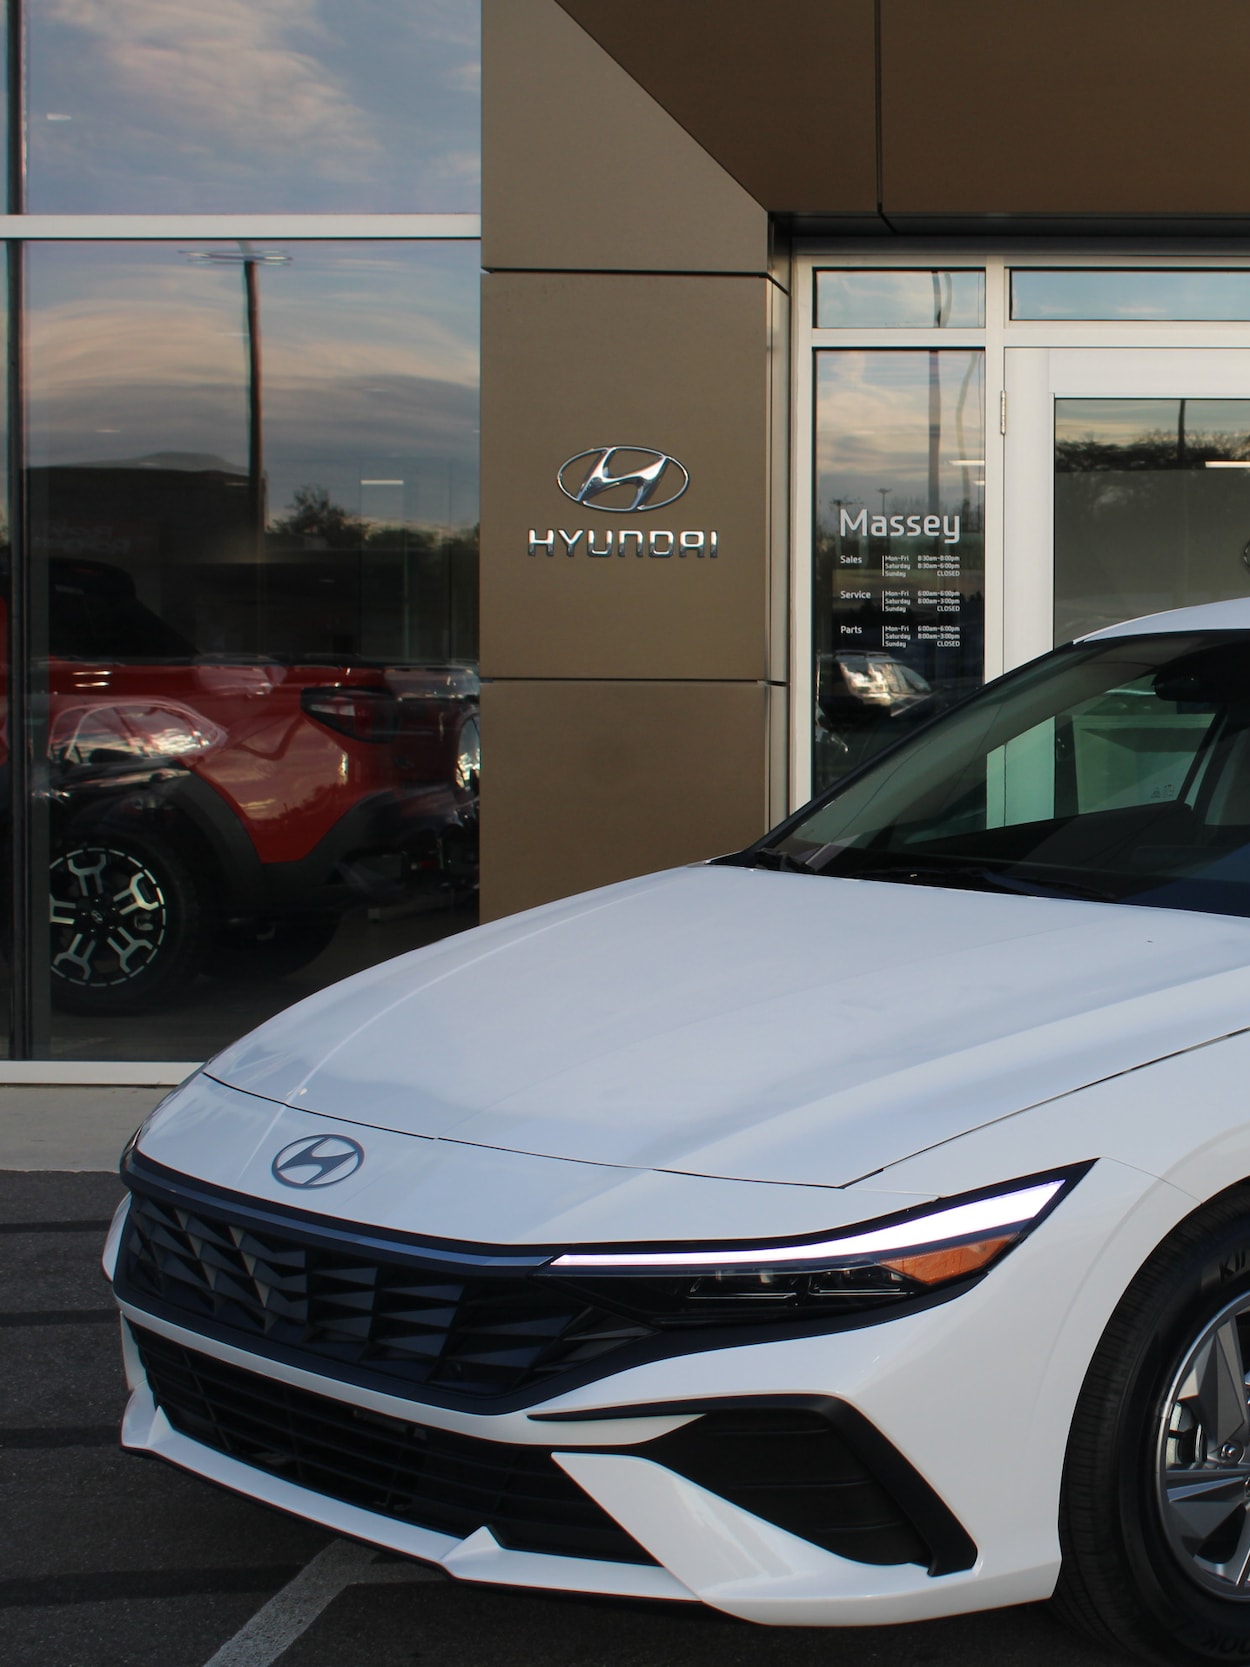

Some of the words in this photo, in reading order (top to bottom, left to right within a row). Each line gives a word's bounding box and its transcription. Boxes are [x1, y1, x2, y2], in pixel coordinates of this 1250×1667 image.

[839, 508, 961, 544] Massey
[527, 528, 719, 558] HYUNDAI
[840, 555, 863, 564] Sales
[884, 562, 911, 570] Saturday
[840, 590, 872, 599] Service
[840, 625, 863, 634] Parts
